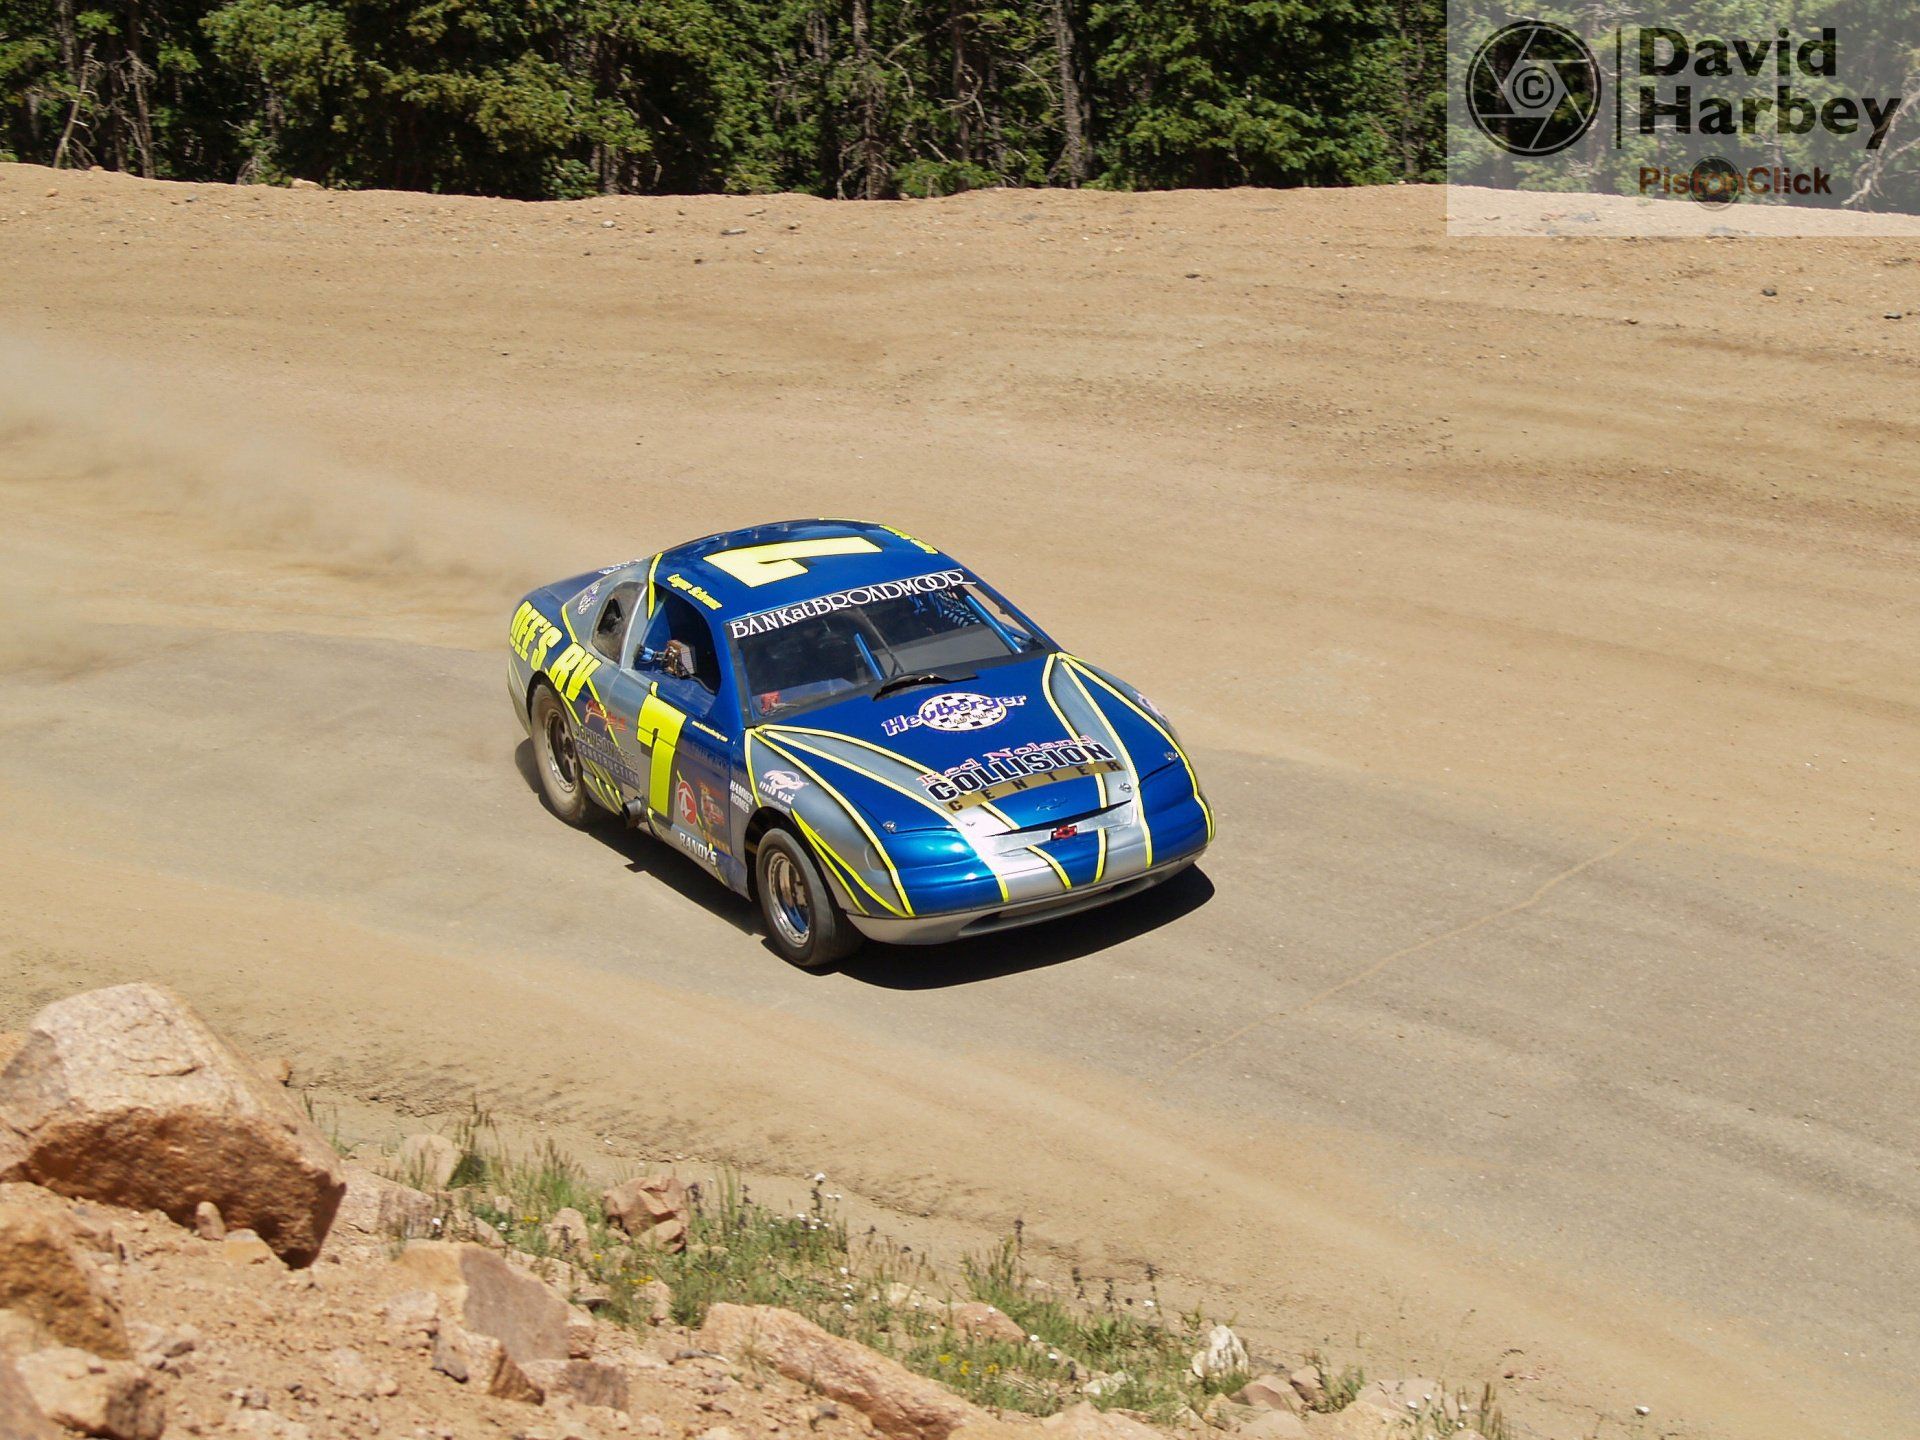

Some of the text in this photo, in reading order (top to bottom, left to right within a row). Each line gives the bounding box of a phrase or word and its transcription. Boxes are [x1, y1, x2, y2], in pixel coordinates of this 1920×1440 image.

[548, 641, 602, 702] RV
[926, 742, 1117, 802] COLLISION
[983, 735, 1099, 763] Noland
[948, 760, 1125, 812] CENTER
